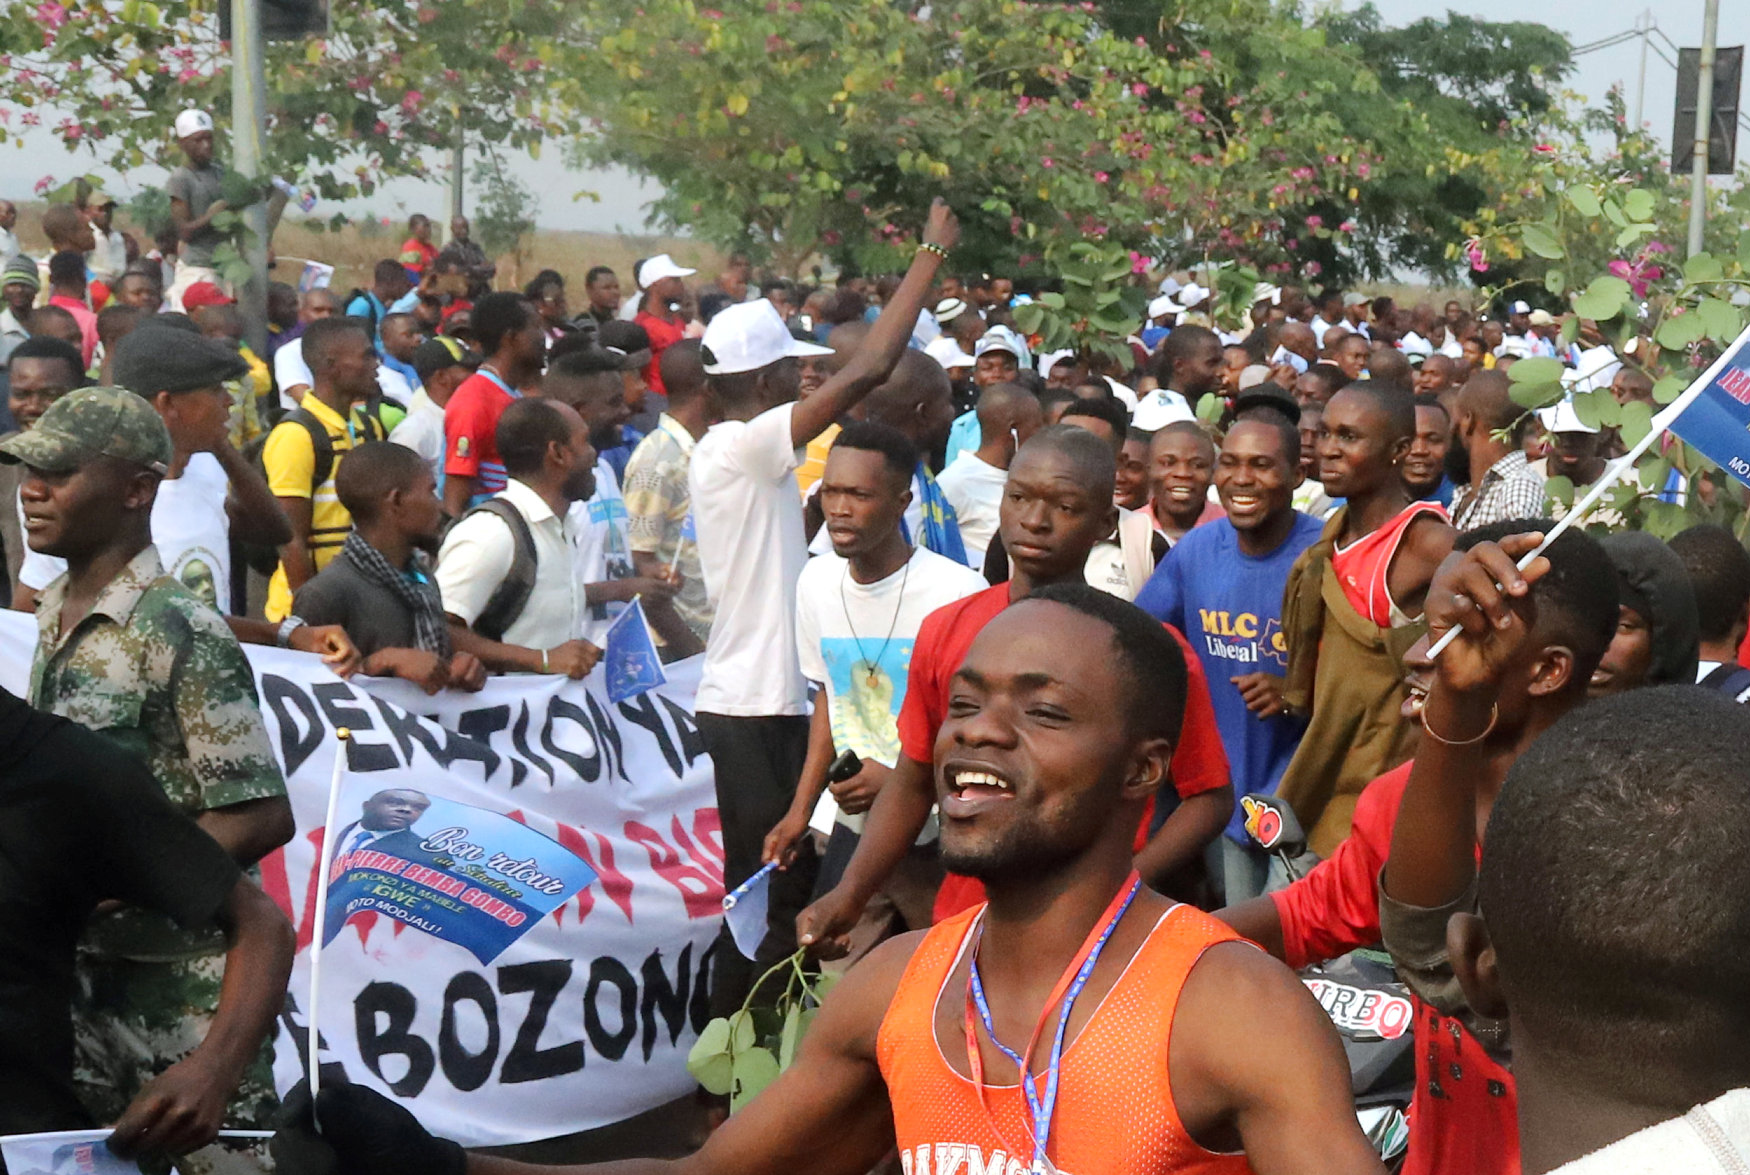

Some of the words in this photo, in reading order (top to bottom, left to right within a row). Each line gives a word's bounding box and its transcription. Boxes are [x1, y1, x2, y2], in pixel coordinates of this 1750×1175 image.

[1199, 608, 1258, 639] MLC
[419, 827, 484, 861] Bon
[486, 852, 565, 896] retour
[371, 885, 422, 908] IGWE
[401, 863, 468, 898] BEMBA
[460, 887, 527, 928] GOMBO
